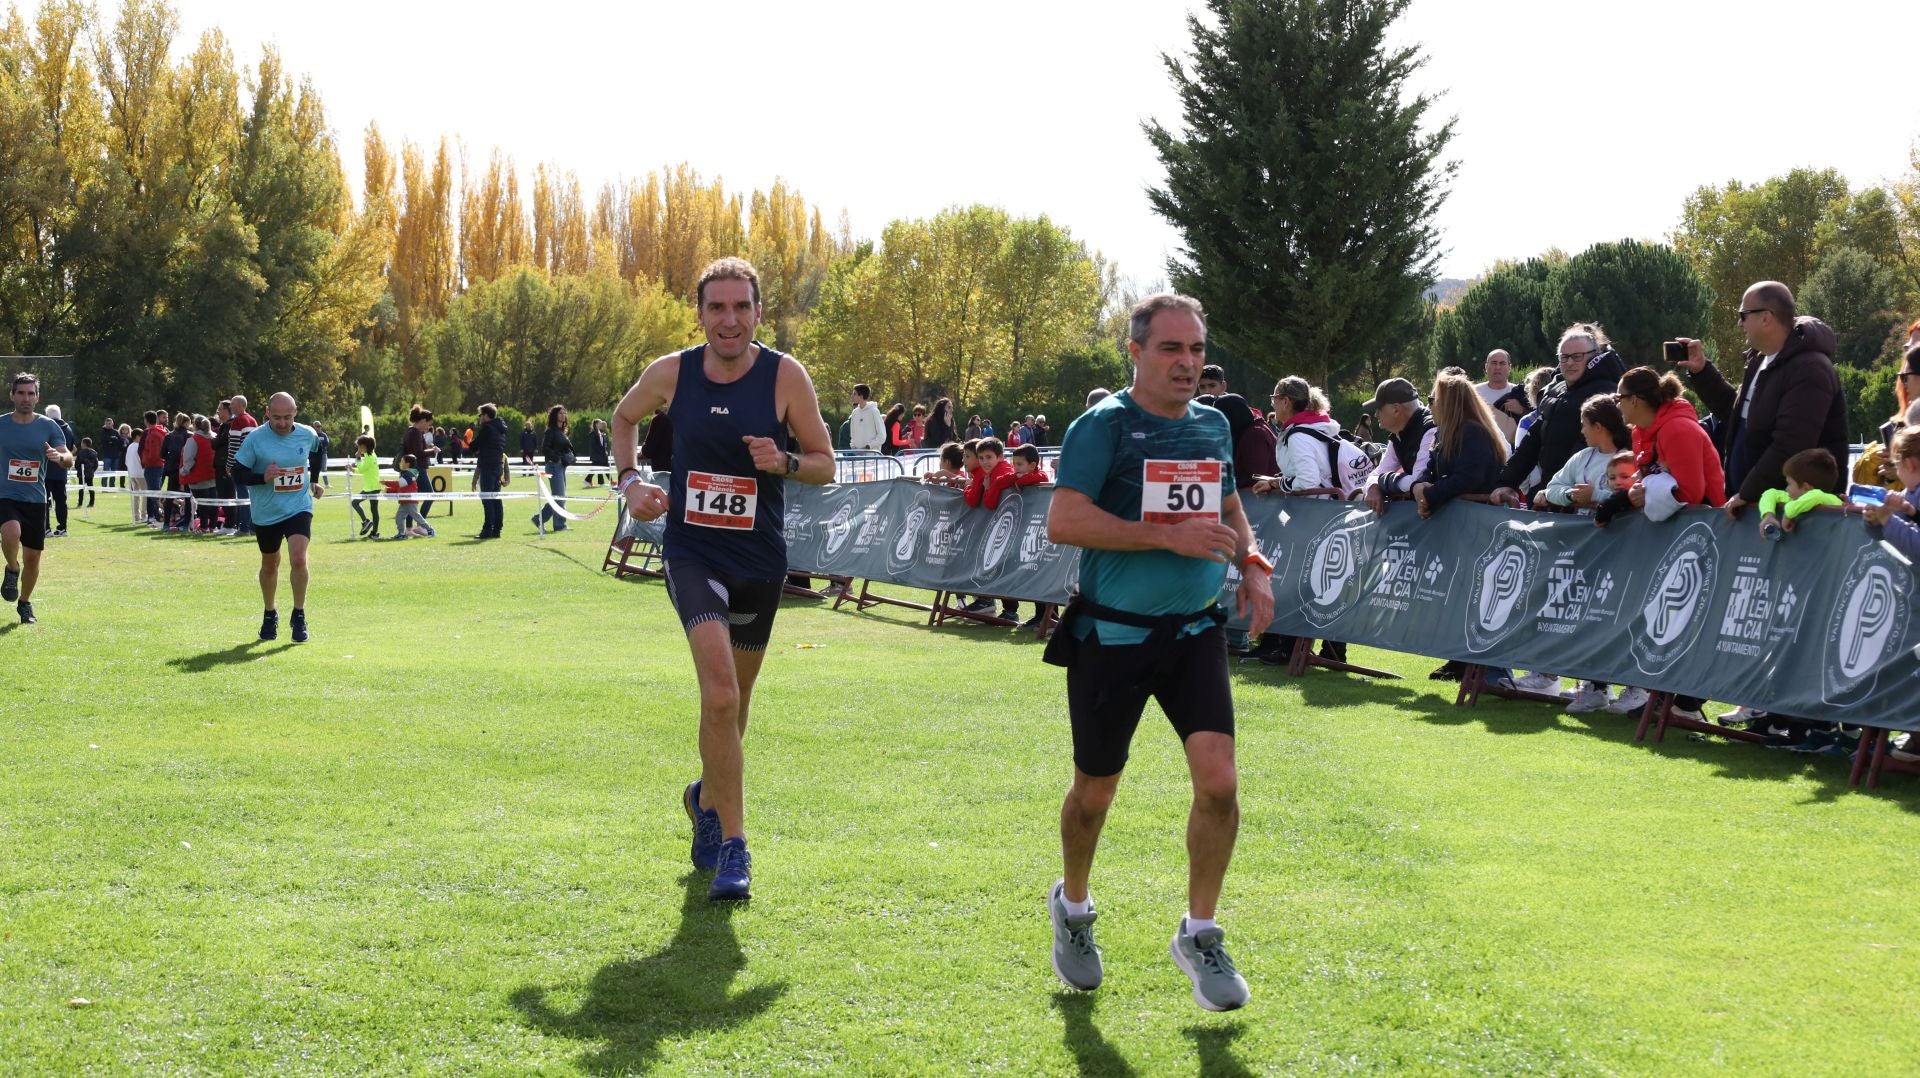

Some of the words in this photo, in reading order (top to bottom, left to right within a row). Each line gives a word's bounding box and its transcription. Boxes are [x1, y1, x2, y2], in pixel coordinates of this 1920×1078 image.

[711, 406, 730, 415] FILA
[16, 467, 32, 477] 46
[279, 474, 302, 485] 174
[711, 476, 734, 484] CROSS
[707, 484, 736, 493] Palencia
[695, 491, 747, 515] 148
[1167, 484, 1205, 511] 50
[1396, 565, 1420, 582] LEN
[1393, 581, 1411, 598] CIA
[1568, 584, 1591, 603] LEN
[1753, 578, 1770, 598] PA
[1564, 604, 1582, 621] CIA
[1748, 599, 1773, 620] LEN
[1743, 620, 1763, 640] CIA
